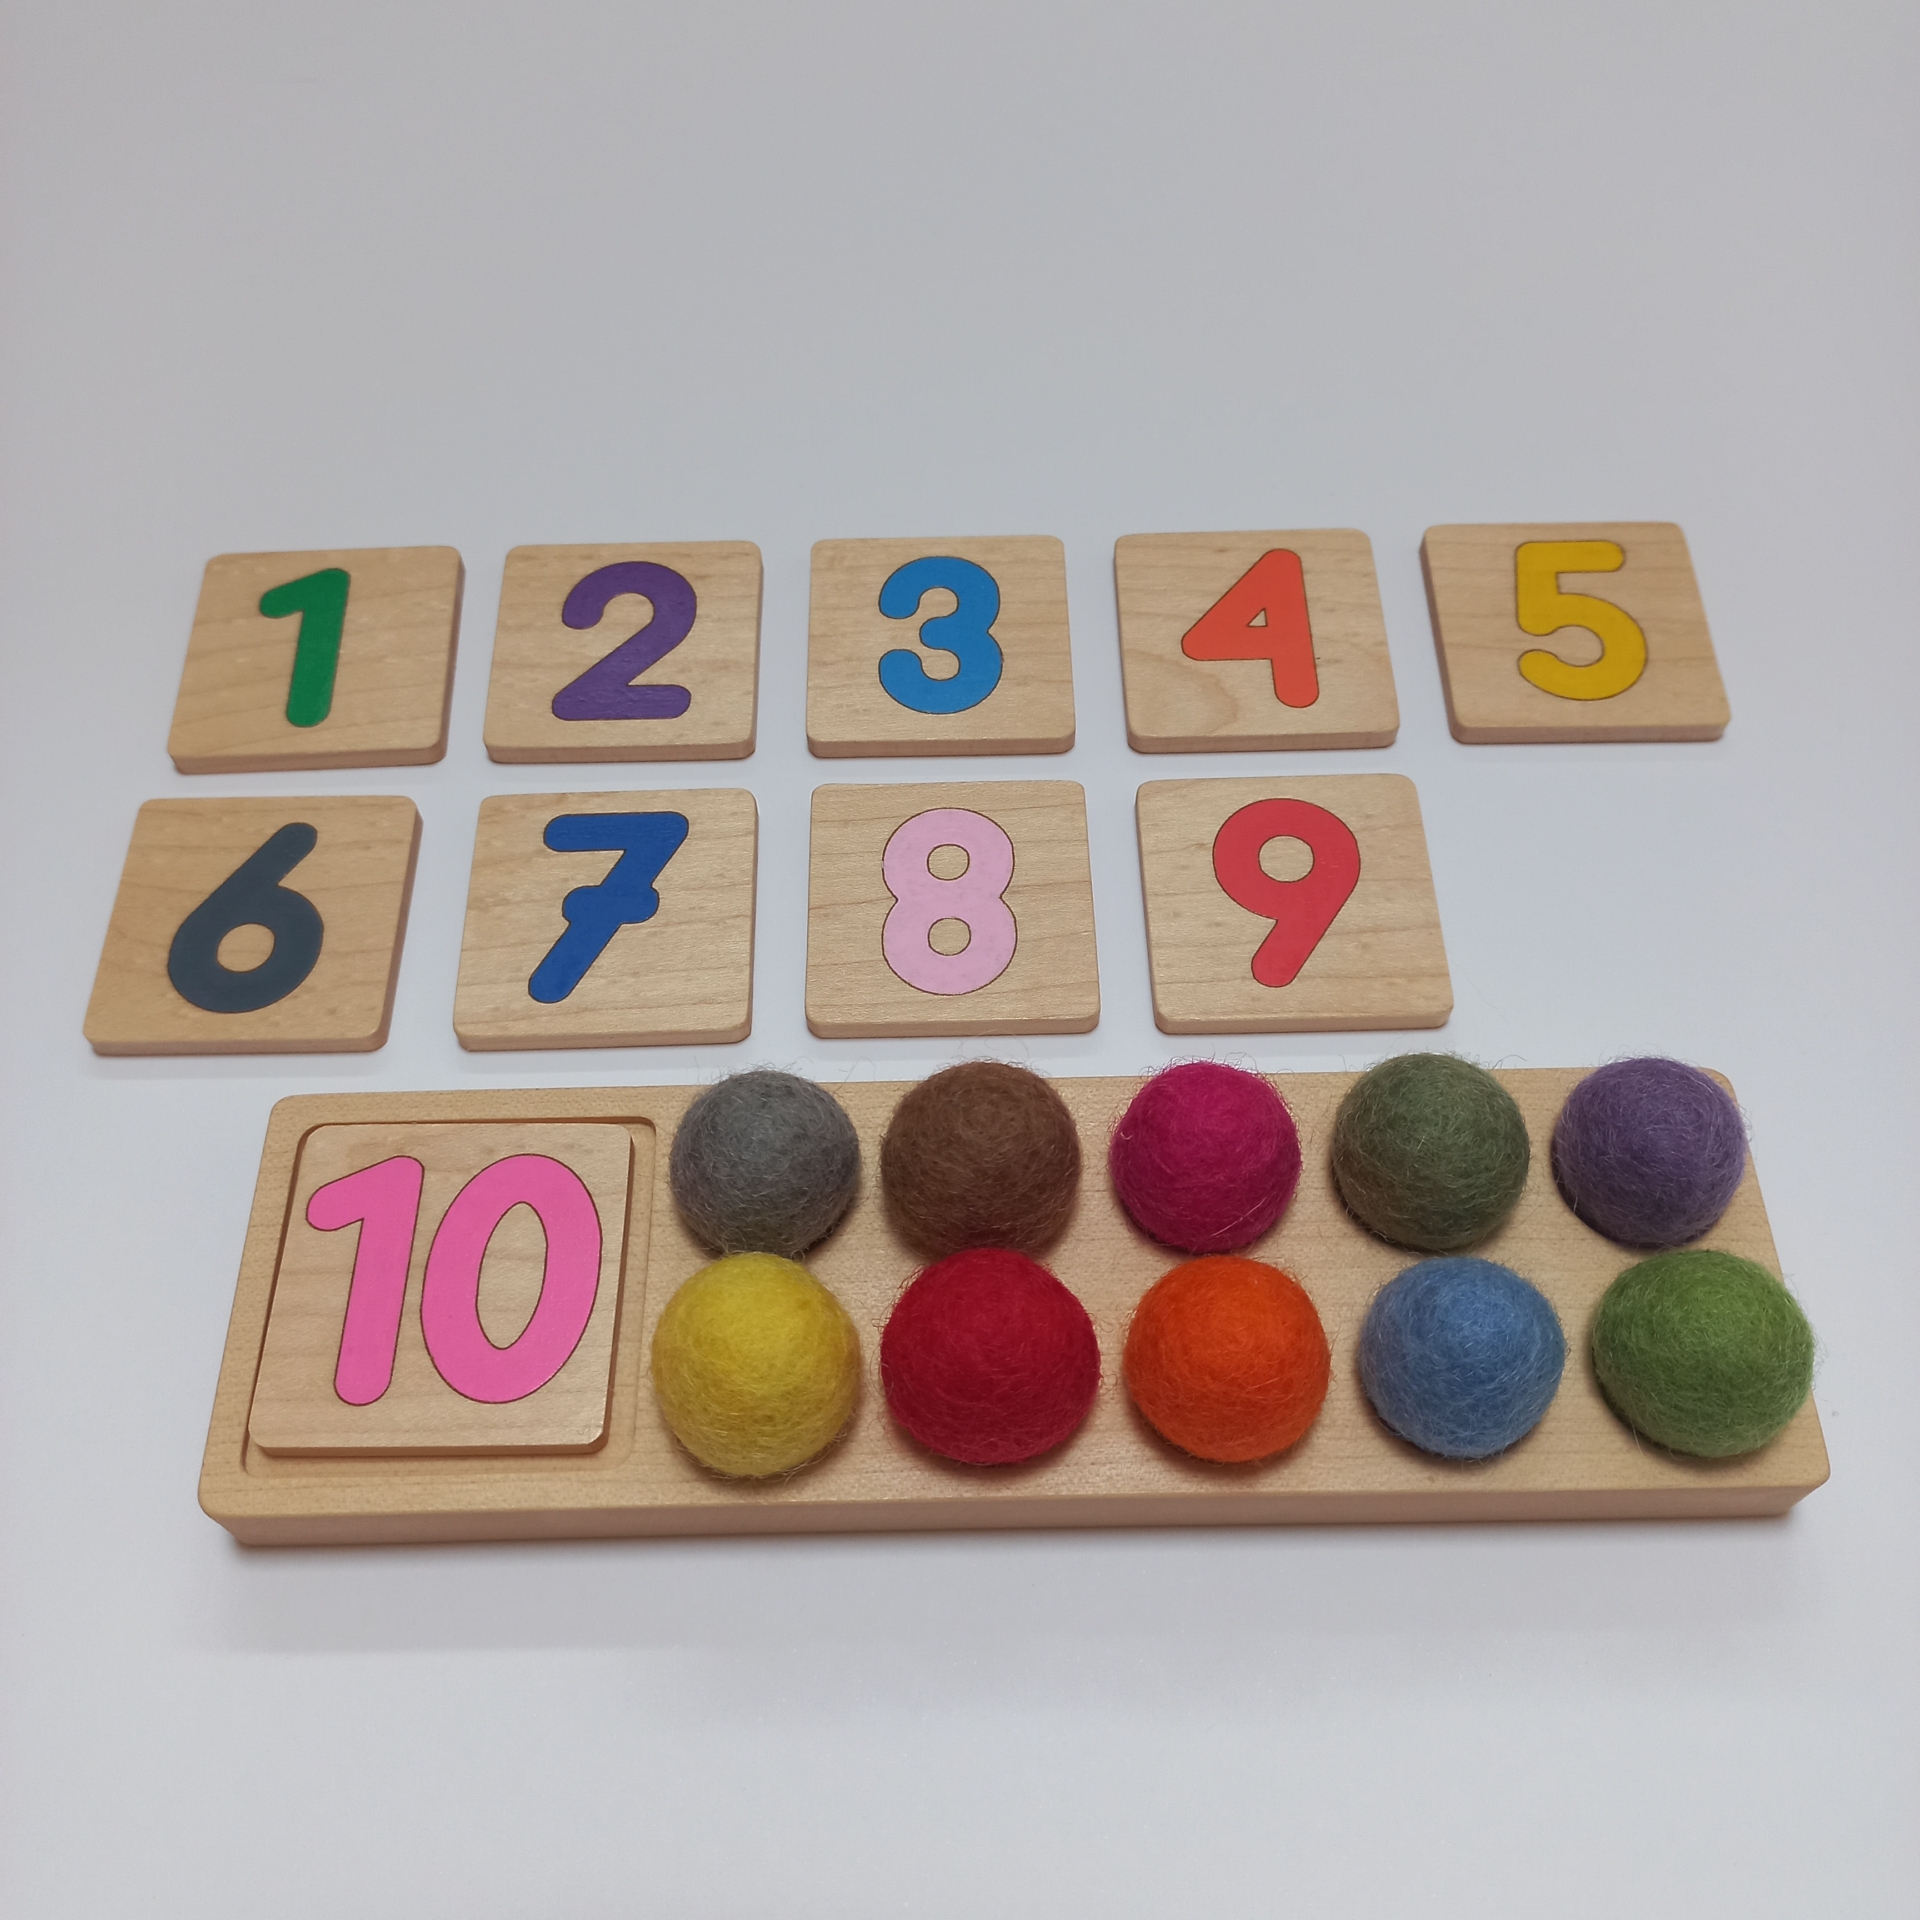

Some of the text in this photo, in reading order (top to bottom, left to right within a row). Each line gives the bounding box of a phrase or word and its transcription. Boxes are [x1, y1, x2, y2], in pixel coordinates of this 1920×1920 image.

[259, 567, 351, 728] 1
[551, 561, 697, 720] 2
[878, 555, 1003, 714] 3
[1181, 548, 1319, 708] 4
[1514, 540, 1647, 701] 5
[167, 822, 325, 1013] 6
[528, 810, 689, 1004] 7
[882, 807, 1018, 996] 8
[1212, 798, 1361, 988] 9
[305, 1153, 603, 1406] 10
